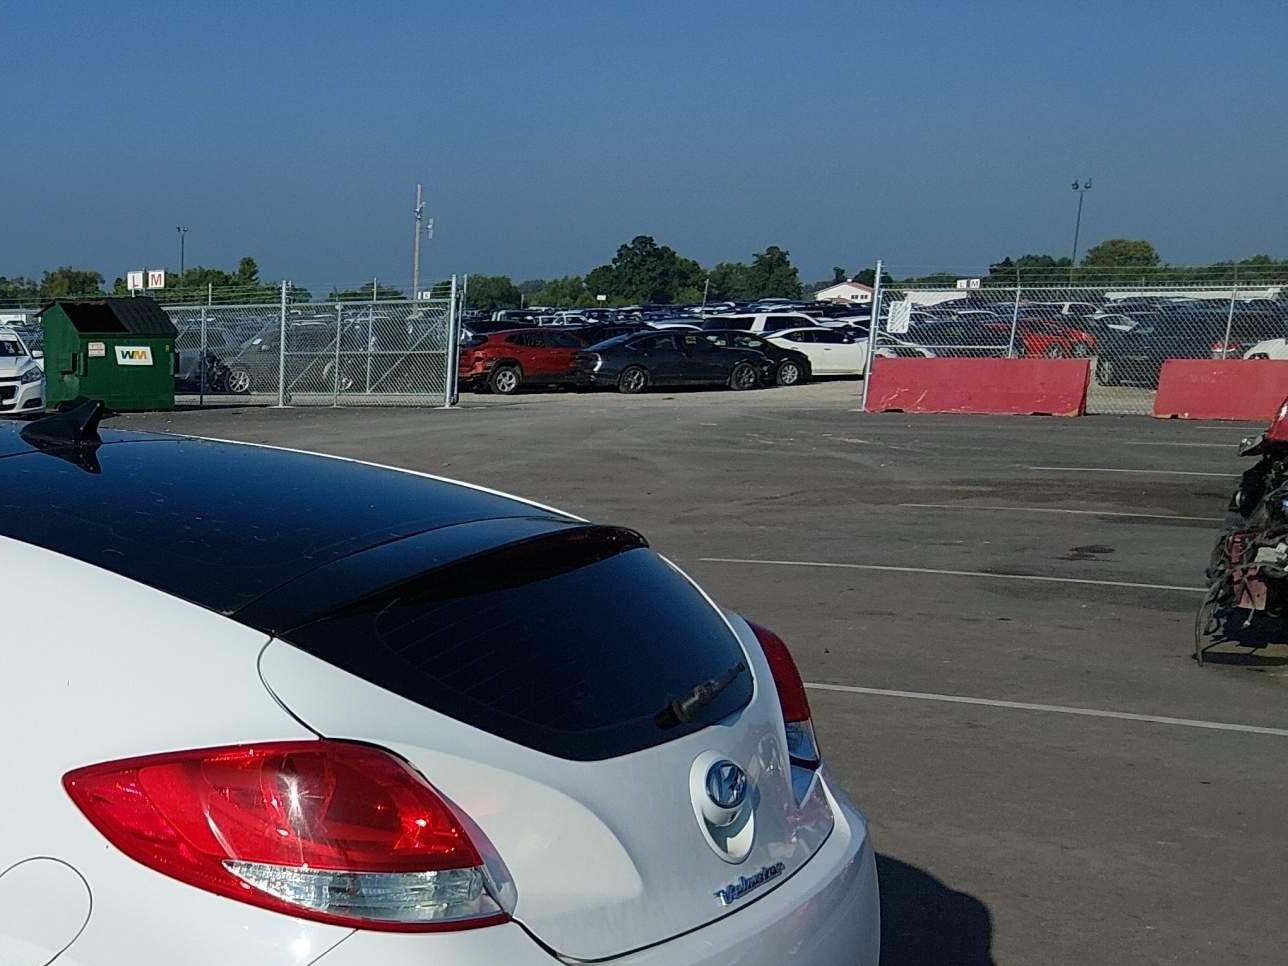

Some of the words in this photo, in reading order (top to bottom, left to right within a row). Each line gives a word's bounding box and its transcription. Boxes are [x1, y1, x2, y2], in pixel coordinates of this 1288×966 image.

[132, 275, 139, 288] L
[150, 273, 162, 286] M
[120, 350, 147, 360] WM
